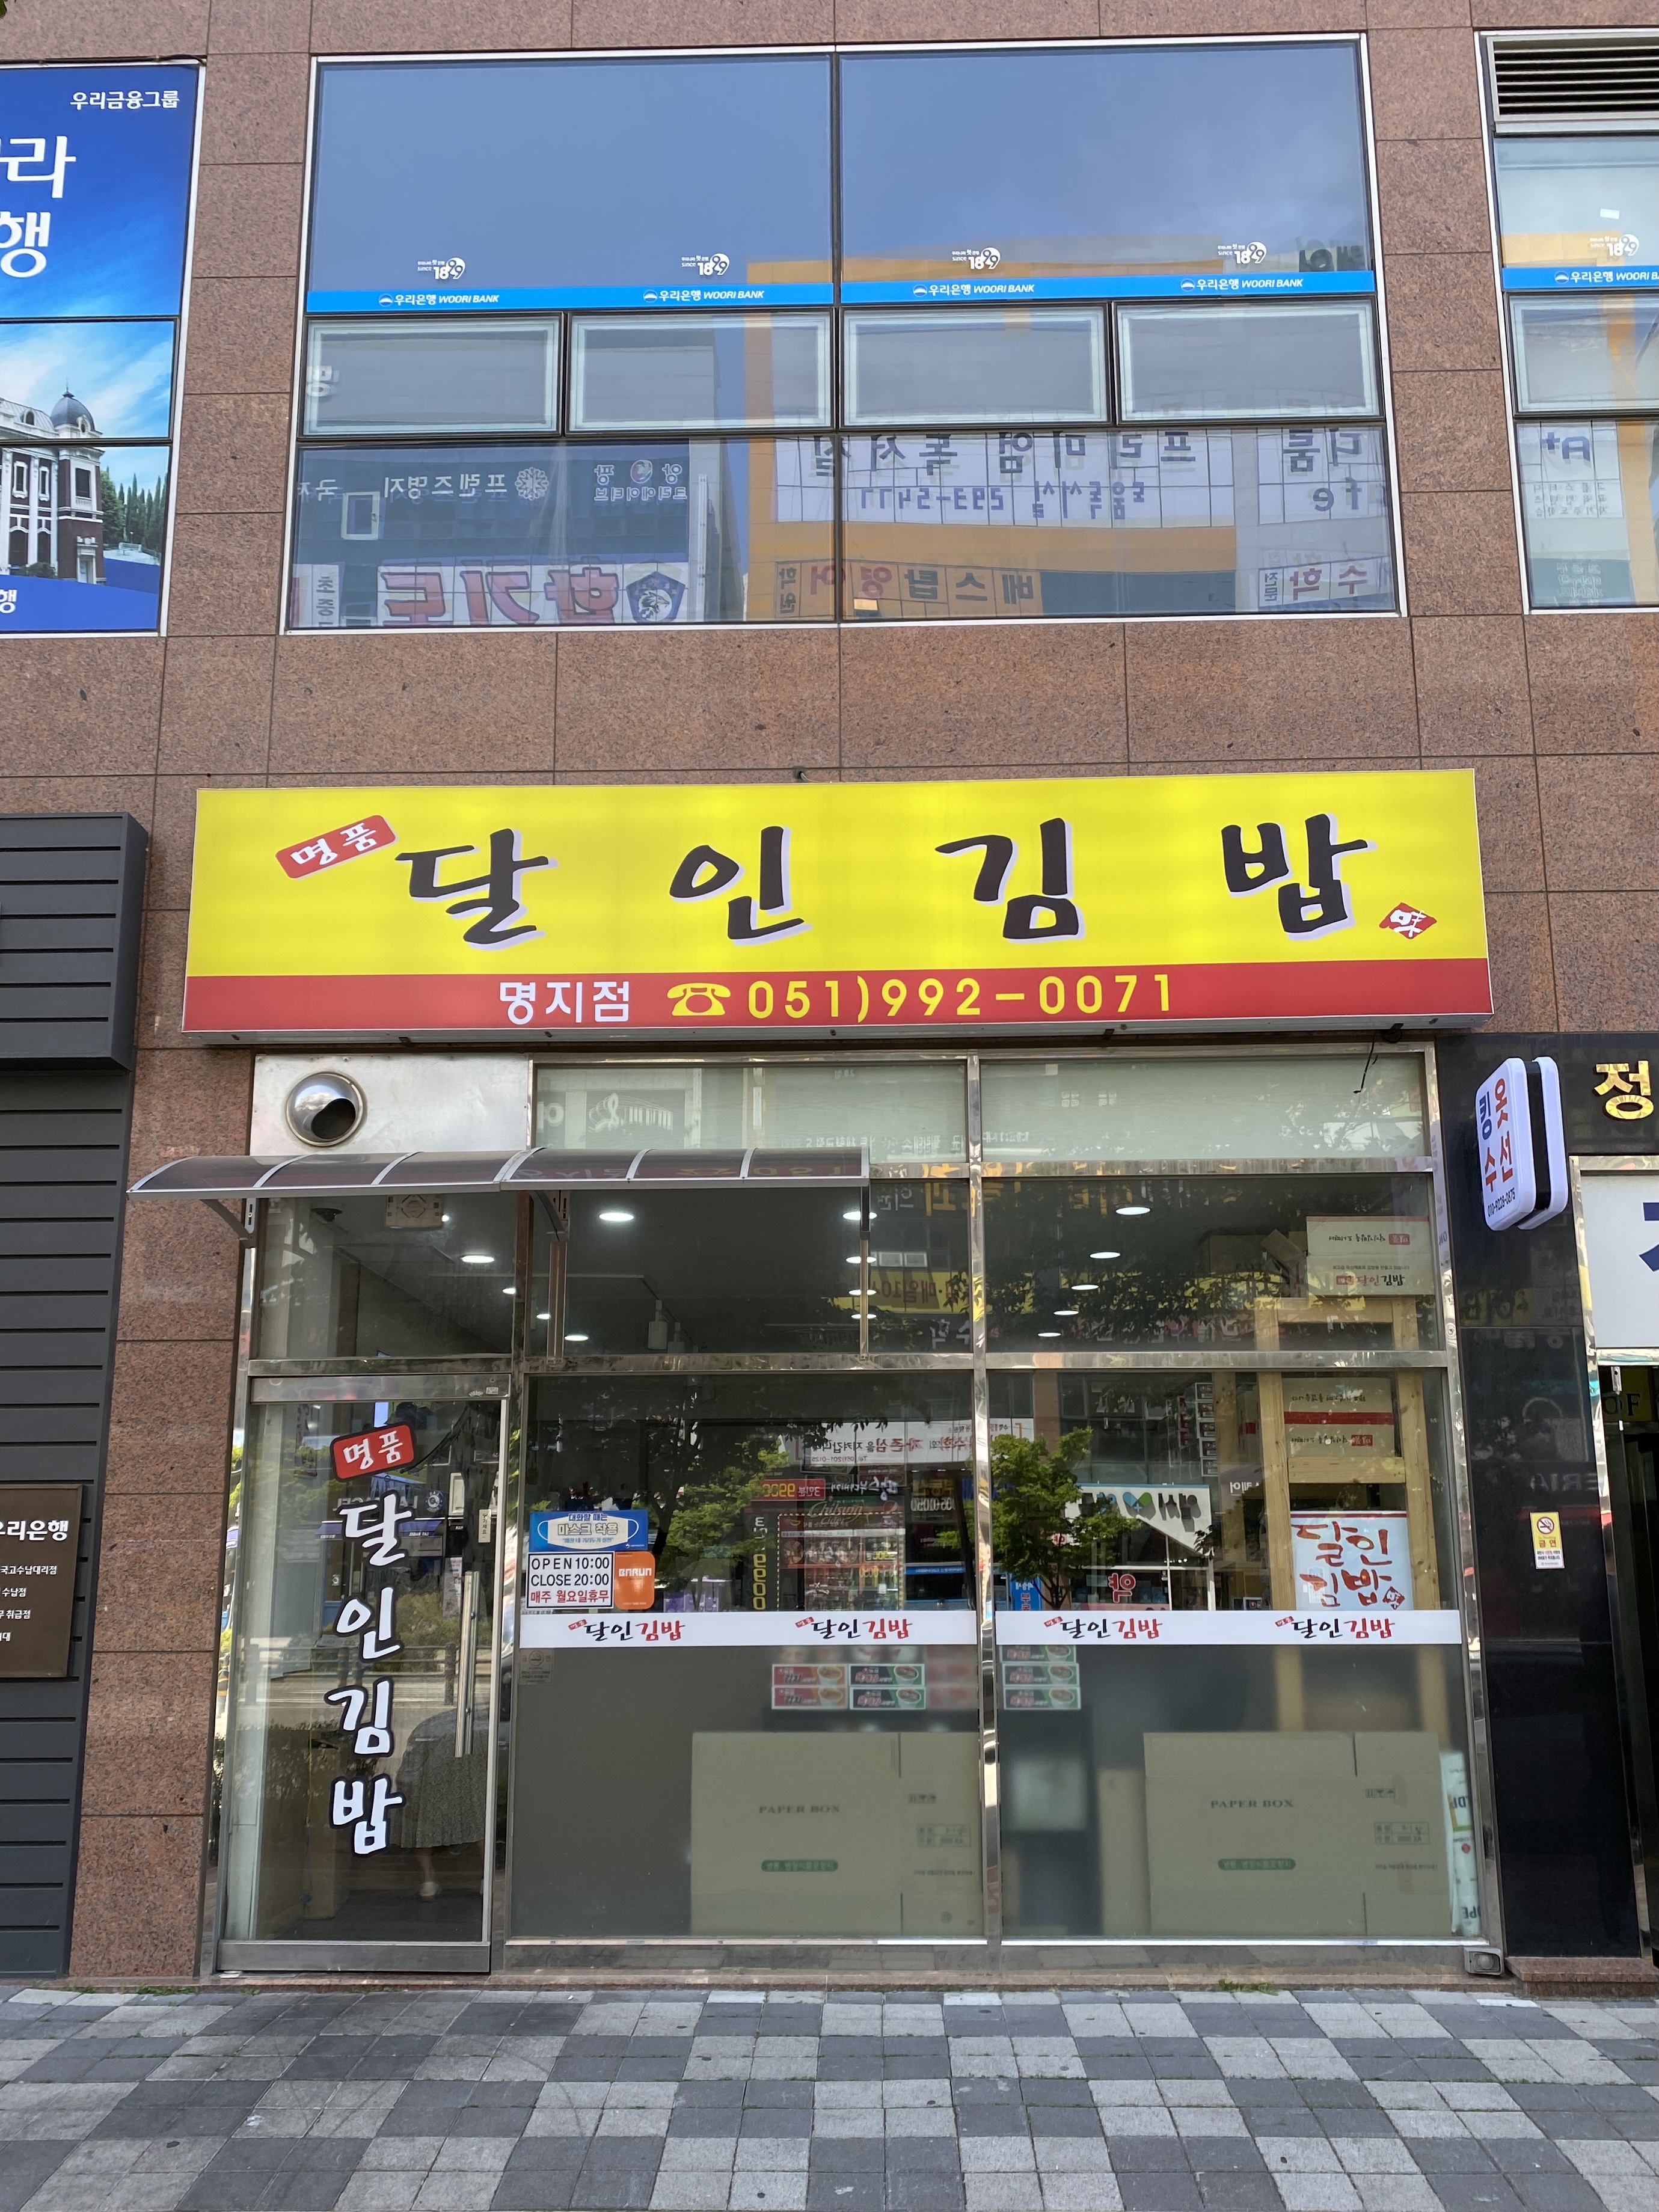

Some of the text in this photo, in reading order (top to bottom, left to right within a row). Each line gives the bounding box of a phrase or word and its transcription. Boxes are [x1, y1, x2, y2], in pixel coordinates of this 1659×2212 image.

[70, 90, 180, 110] 우리금융그룹
[0, 136, 76, 198] 라
[1276, 279, 1303, 287] BANK
[1571, 271, 1613, 283] 우리은행
[928, 284, 971, 296] 우리은행
[1008, 284, 1035, 293] BANK
[1197, 278, 1239, 290] 우리은행
[394, 294, 437, 305] 우리은행
[438, 295, 500, 304] WOORI BANK
[658, 290, 701, 302] 우리은행
[738, 290, 765, 299] BANK
[290, 822, 376, 865] 명품
[394, 813, 1371, 945] 달인김밥
[500, 974, 1170, 1025] 명지점 051)992-0071
[1593, 1060, 1654, 1120] 정
[342, 1430, 403, 1469] 명품
[592, 1513, 608, 1521] 때는
[0, 1520, 69, 1541] 리은행
[558, 1522, 618, 1536] 마스크 착용
[1291, 1521, 1393, 1567] 달인
[532, 1557, 609, 1570] OPEN 10:00
[1, 1566, 57, 1575] 국고수납대리점
[531, 1573, 609, 1586] CLOSE 20:00
[2, 1587, 26, 1598] 수납점
[1300, 1569, 1393, 1607] 김밥
[530, 1590, 609, 1604] 매주 월요일휴무
[6, 1610, 31, 1619] 취급점
[584, 1620, 686, 1641] 달인김밥
[811, 1618, 913, 1639] 달인김밥
[1060, 1617, 1163, 1639] 달인김밥
[1292, 1617, 1396, 1638] 달인김밥
[328, 1494, 412, 1854] 달인김밥
[759, 1806, 806, 1814] PAPER
[1210, 1799, 1295, 1809] PAPER BOX
